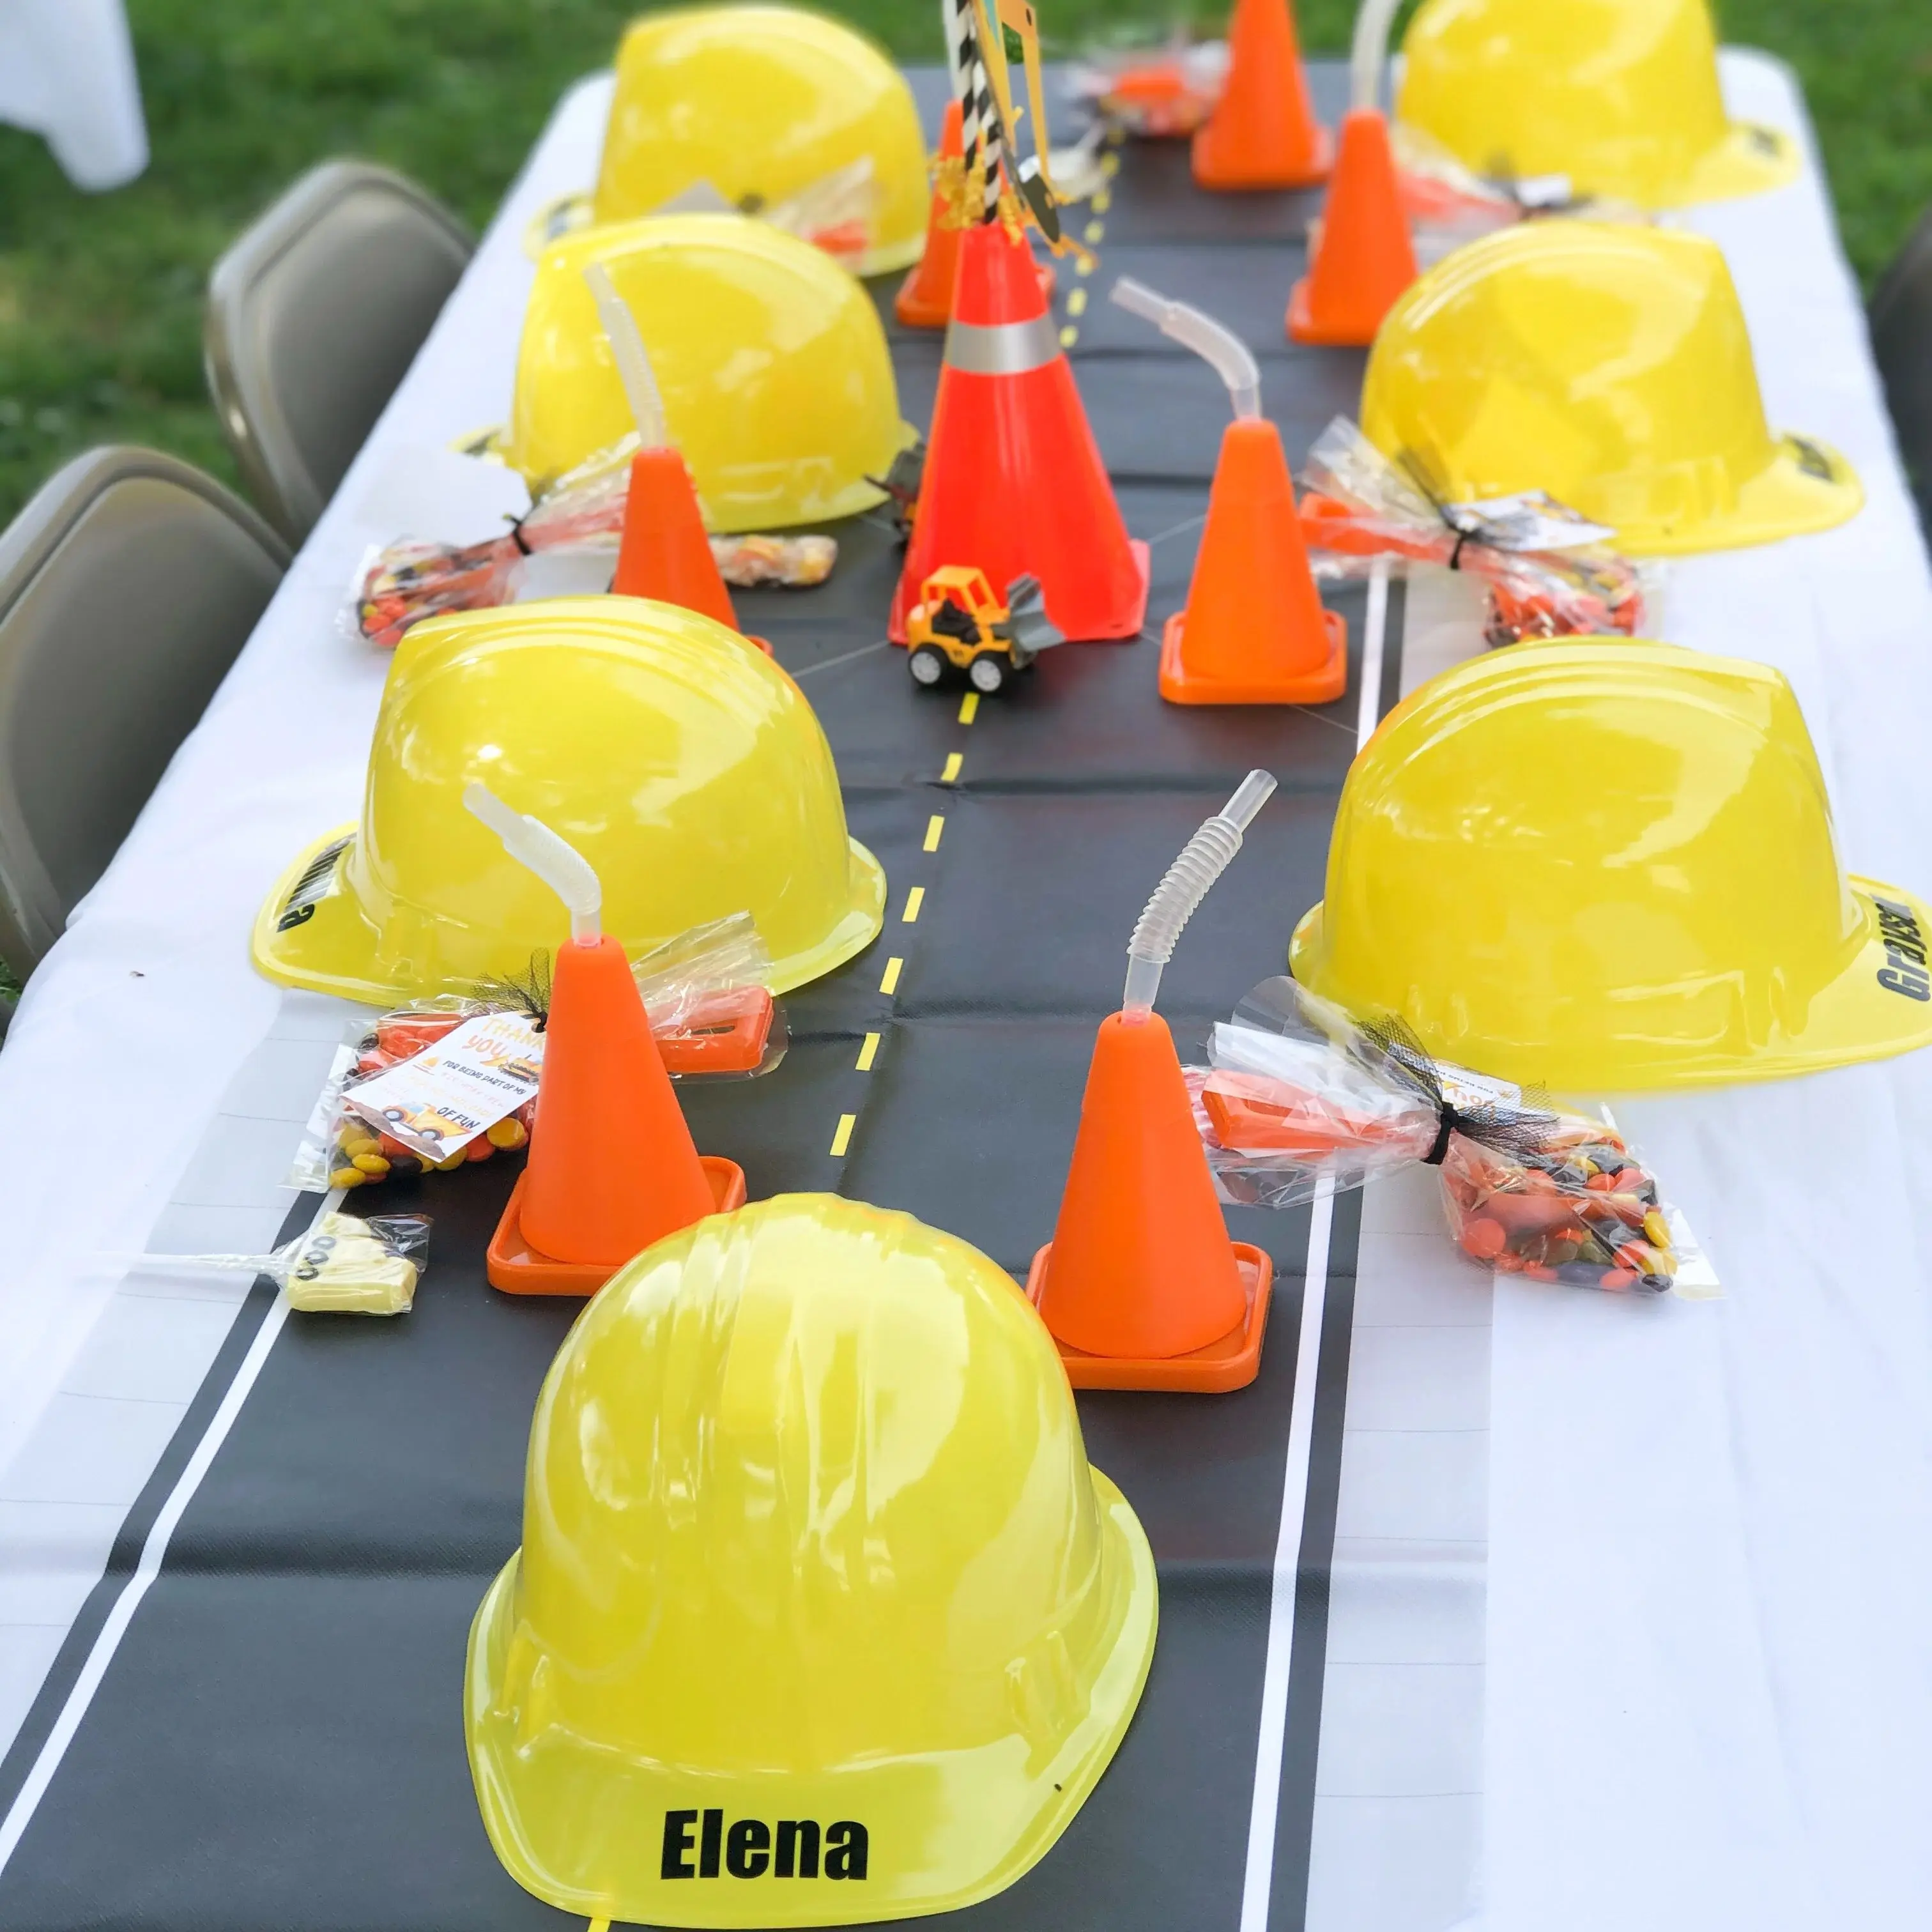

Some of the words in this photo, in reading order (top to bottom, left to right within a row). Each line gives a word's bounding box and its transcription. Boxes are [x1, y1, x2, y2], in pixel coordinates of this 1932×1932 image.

[461, 1034, 508, 1057] YOU
[442, 1059, 460, 1070] FOR
[457, 1066, 484, 1080] BEING
[480, 1075, 505, 1086] PART
[502, 1082, 516, 1091] OF
[512, 1086, 527, 1095] MY
[436, 1107, 457, 1118] OF
[451, 1113, 481, 1130] FUN
[661, 1809, 869, 1880] Elena
